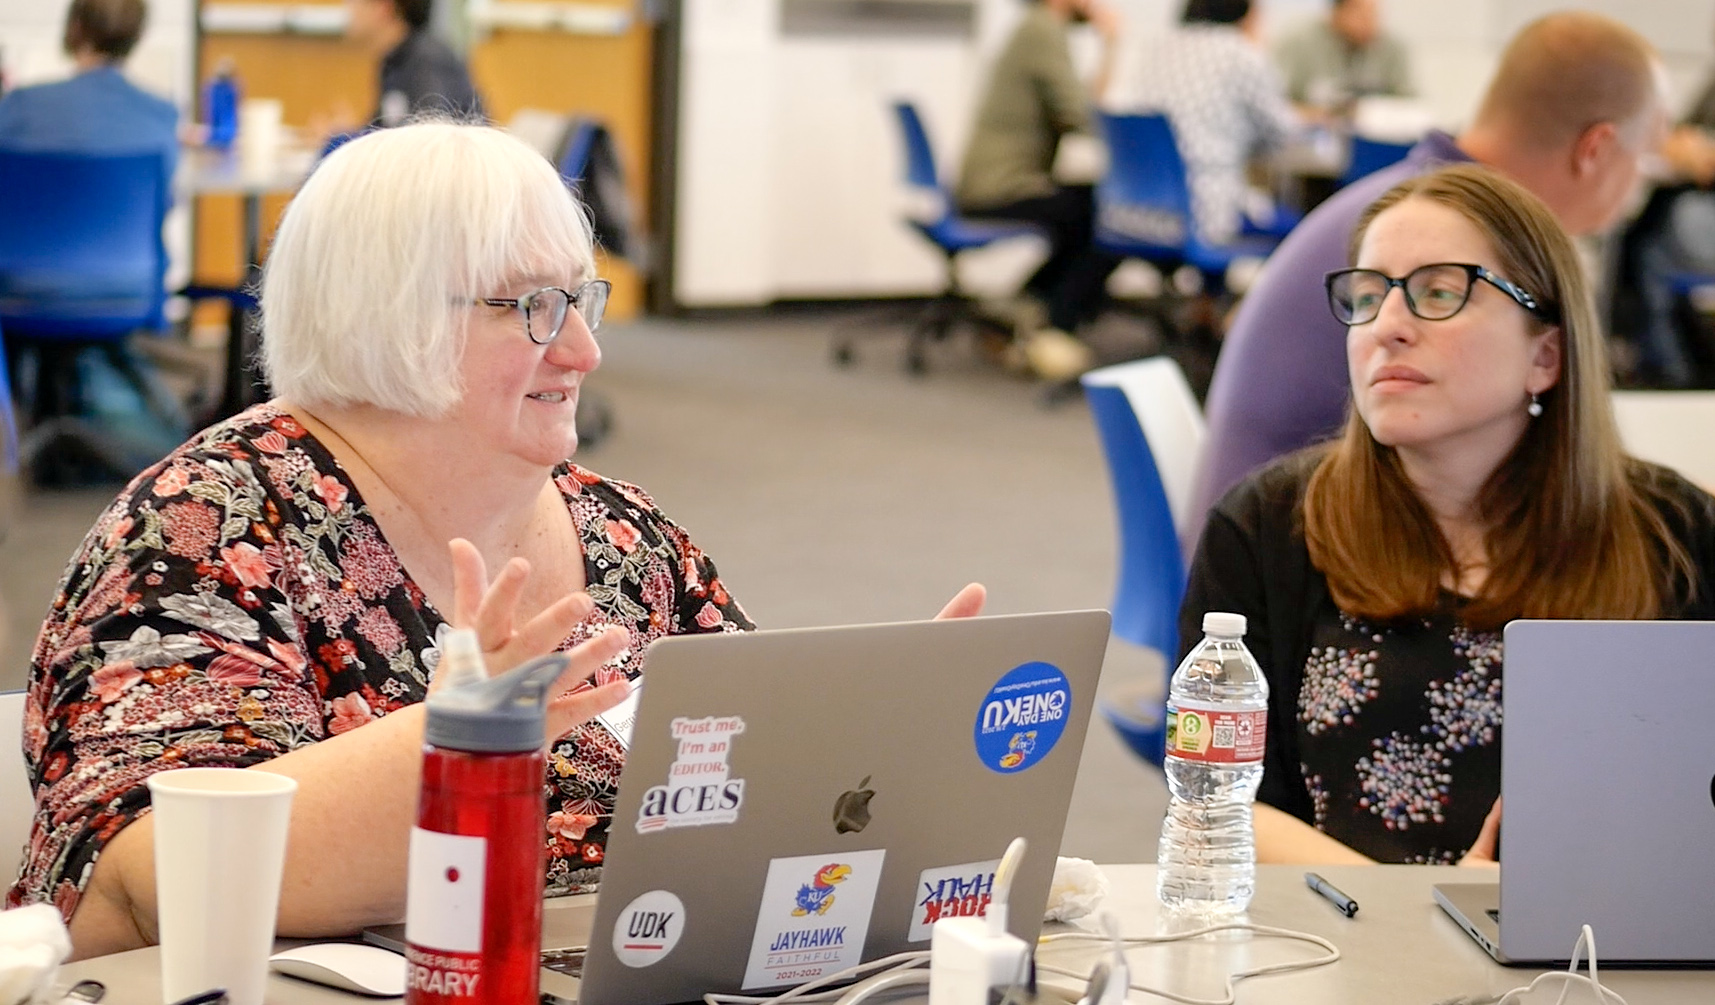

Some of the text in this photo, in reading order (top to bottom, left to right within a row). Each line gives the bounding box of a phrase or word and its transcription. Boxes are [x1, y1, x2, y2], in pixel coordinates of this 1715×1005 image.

[982, 689, 1066, 728] ONEKU
[1017, 709, 1062, 727] ONE DAY
[674, 720, 711, 735] Trust
[708, 741, 727, 753] an
[673, 761, 725, 776] EDITOR.
[807, 891, 823, 902] KU
[628, 910, 675, 938] UDK
[770, 926, 848, 951] JAYHAWK
[434, 955, 481, 971] PUBLIC
[766, 951, 841, 966] FAITHFUL
[775, 968, 823, 980] 2021-2022
